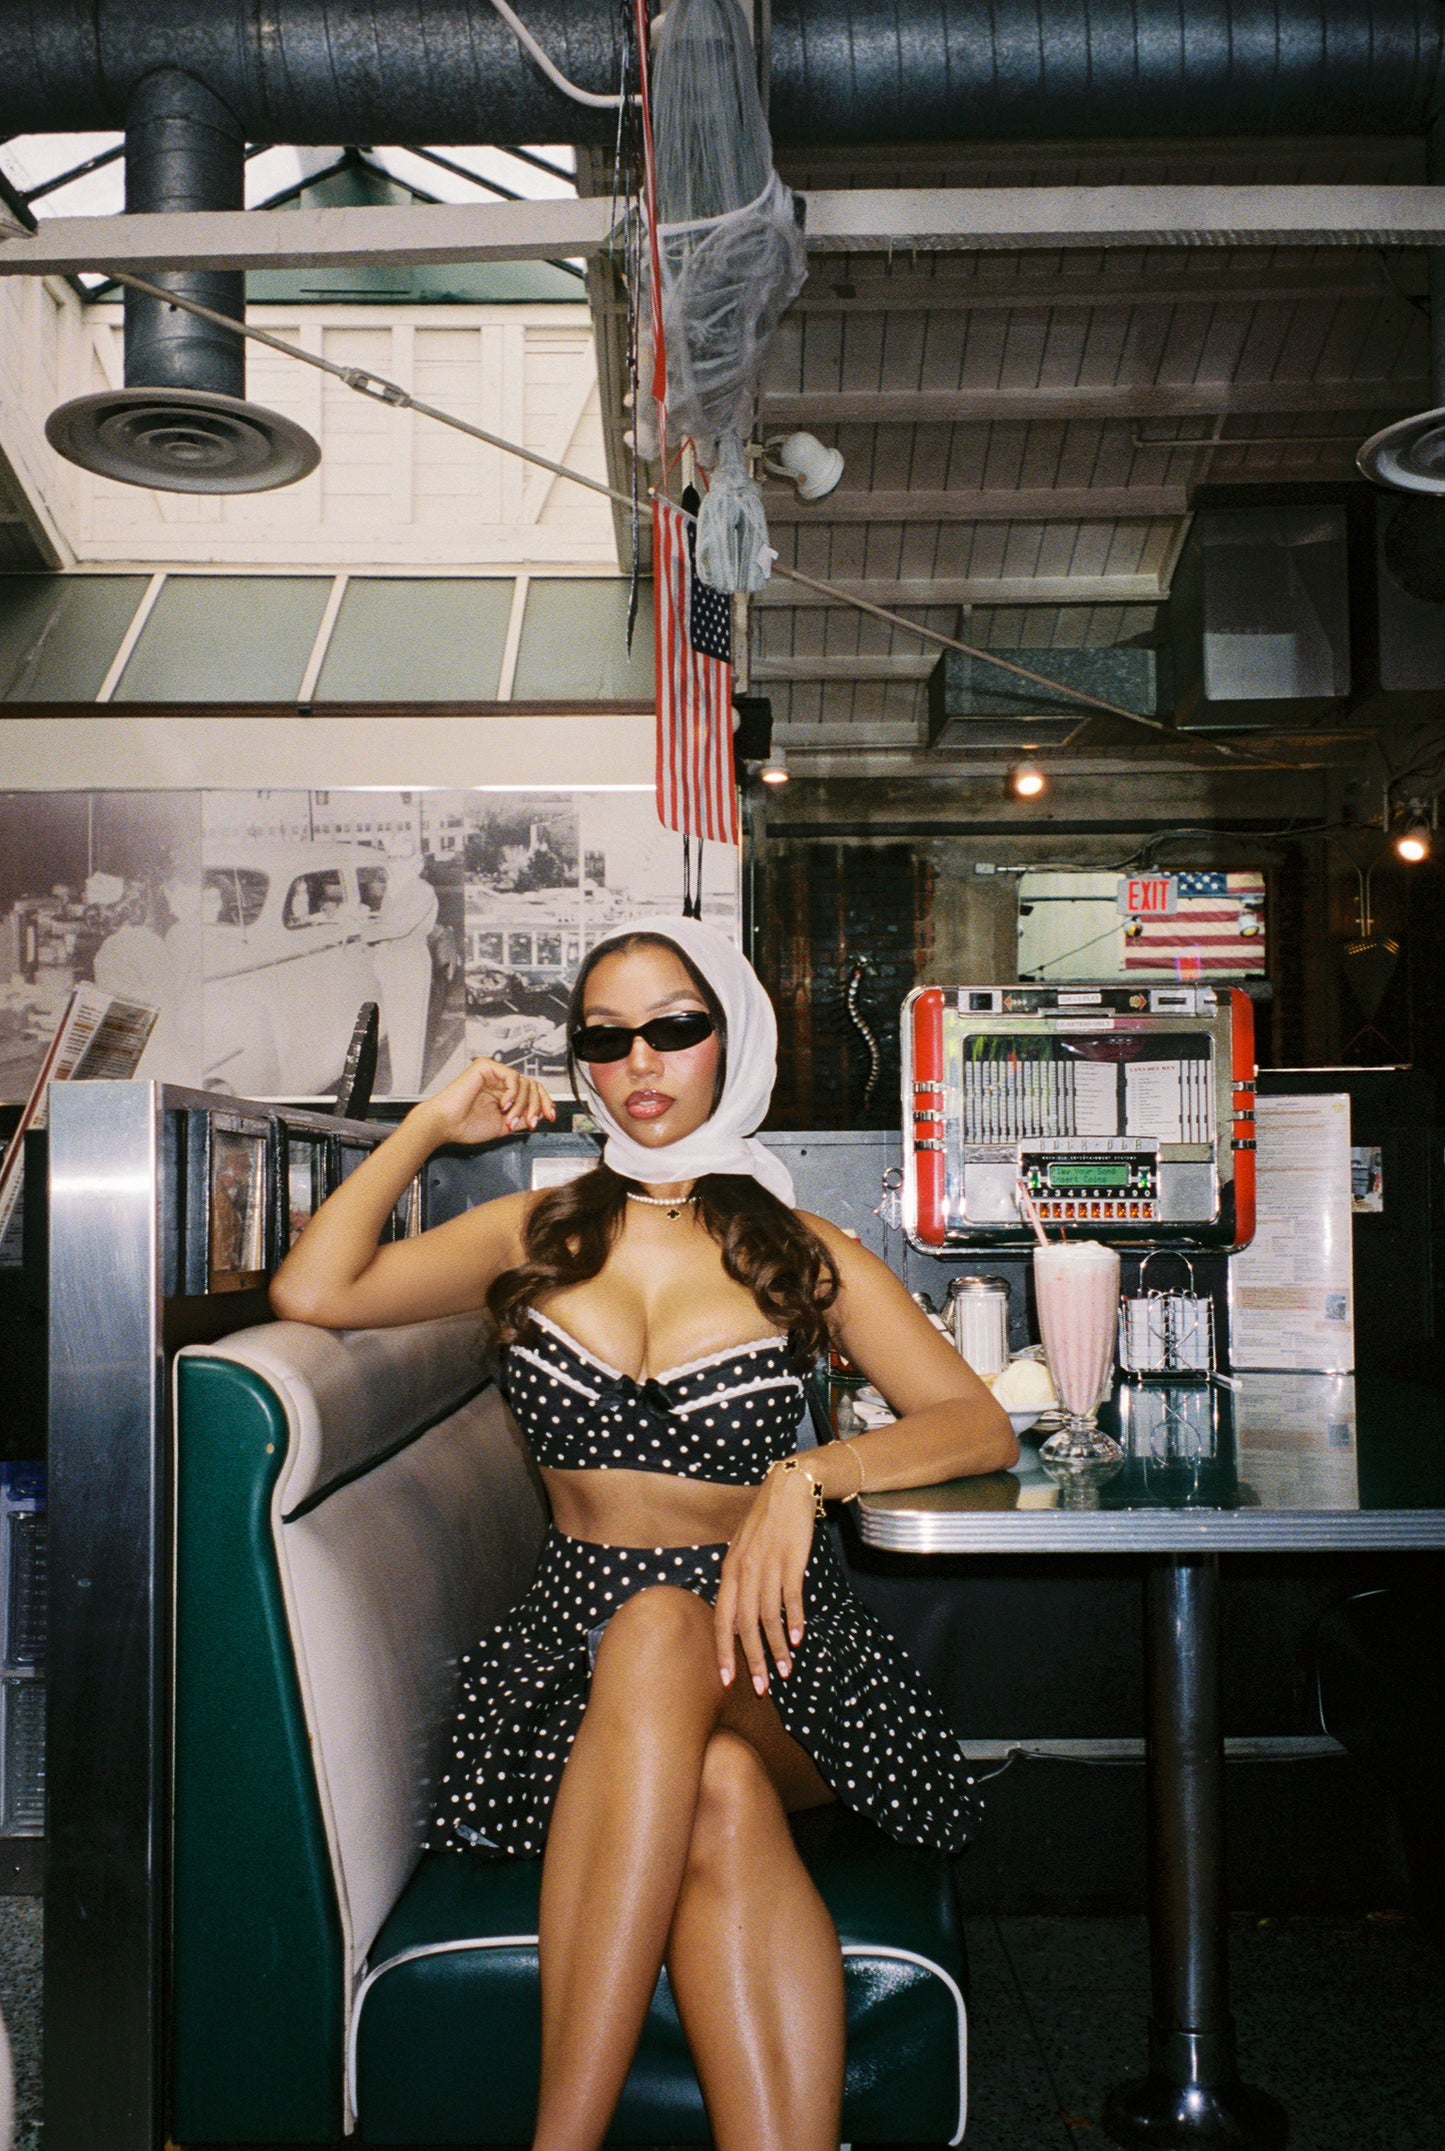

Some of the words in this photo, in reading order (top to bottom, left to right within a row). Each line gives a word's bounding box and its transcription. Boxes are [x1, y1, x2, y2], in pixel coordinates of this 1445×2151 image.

[1128, 880, 1170, 911] EXIT
[1042, 1189, 1049, 1197] 2
[1054, 1189, 1061, 1197] 3
[1067, 1189, 1074, 1197] 4
[1081, 1189, 1087, 1197] 5
[1093, 1189, 1100, 1197] 6
[1106, 1189, 1113, 1197] 7
[1119, 1189, 1125, 1197] 8
[1131, 1189, 1138, 1197] 9
[1144, 1189, 1151, 1197] 0
